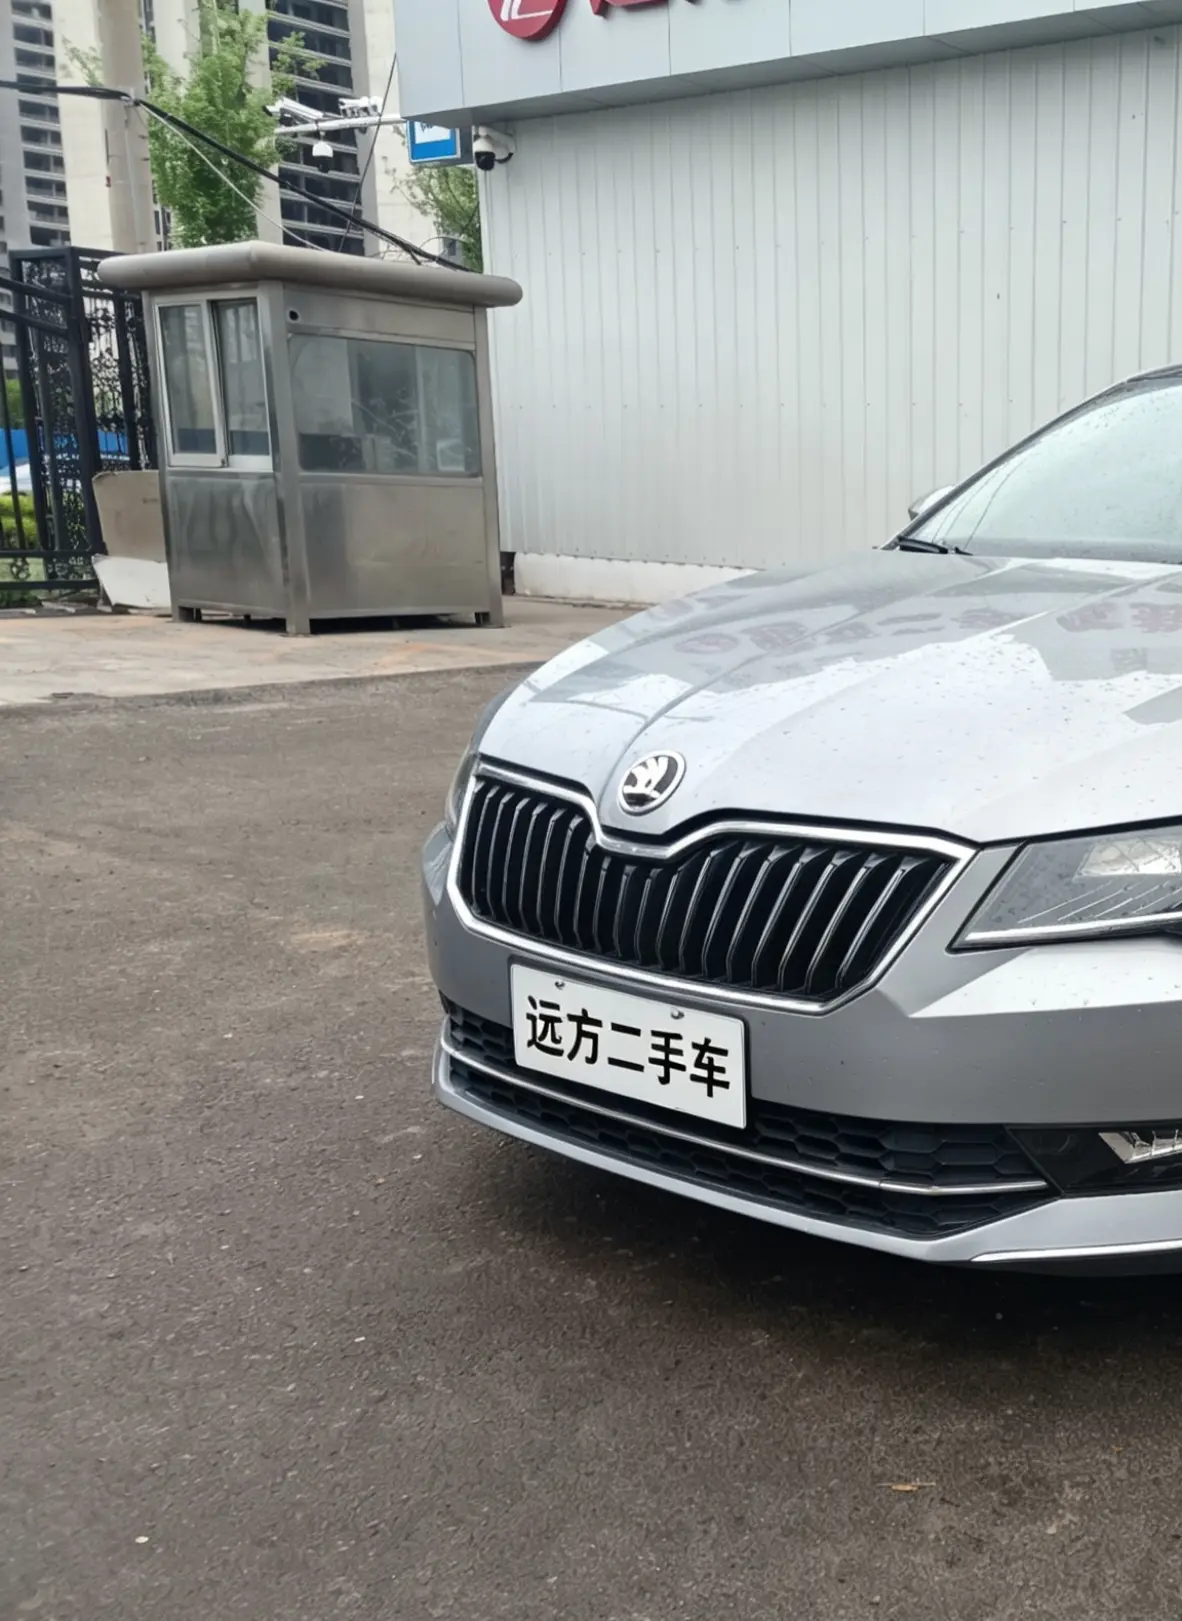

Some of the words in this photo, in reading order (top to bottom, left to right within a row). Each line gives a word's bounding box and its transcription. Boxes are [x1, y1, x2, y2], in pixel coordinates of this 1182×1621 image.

[525, 995, 731, 1098] 远方二手车
